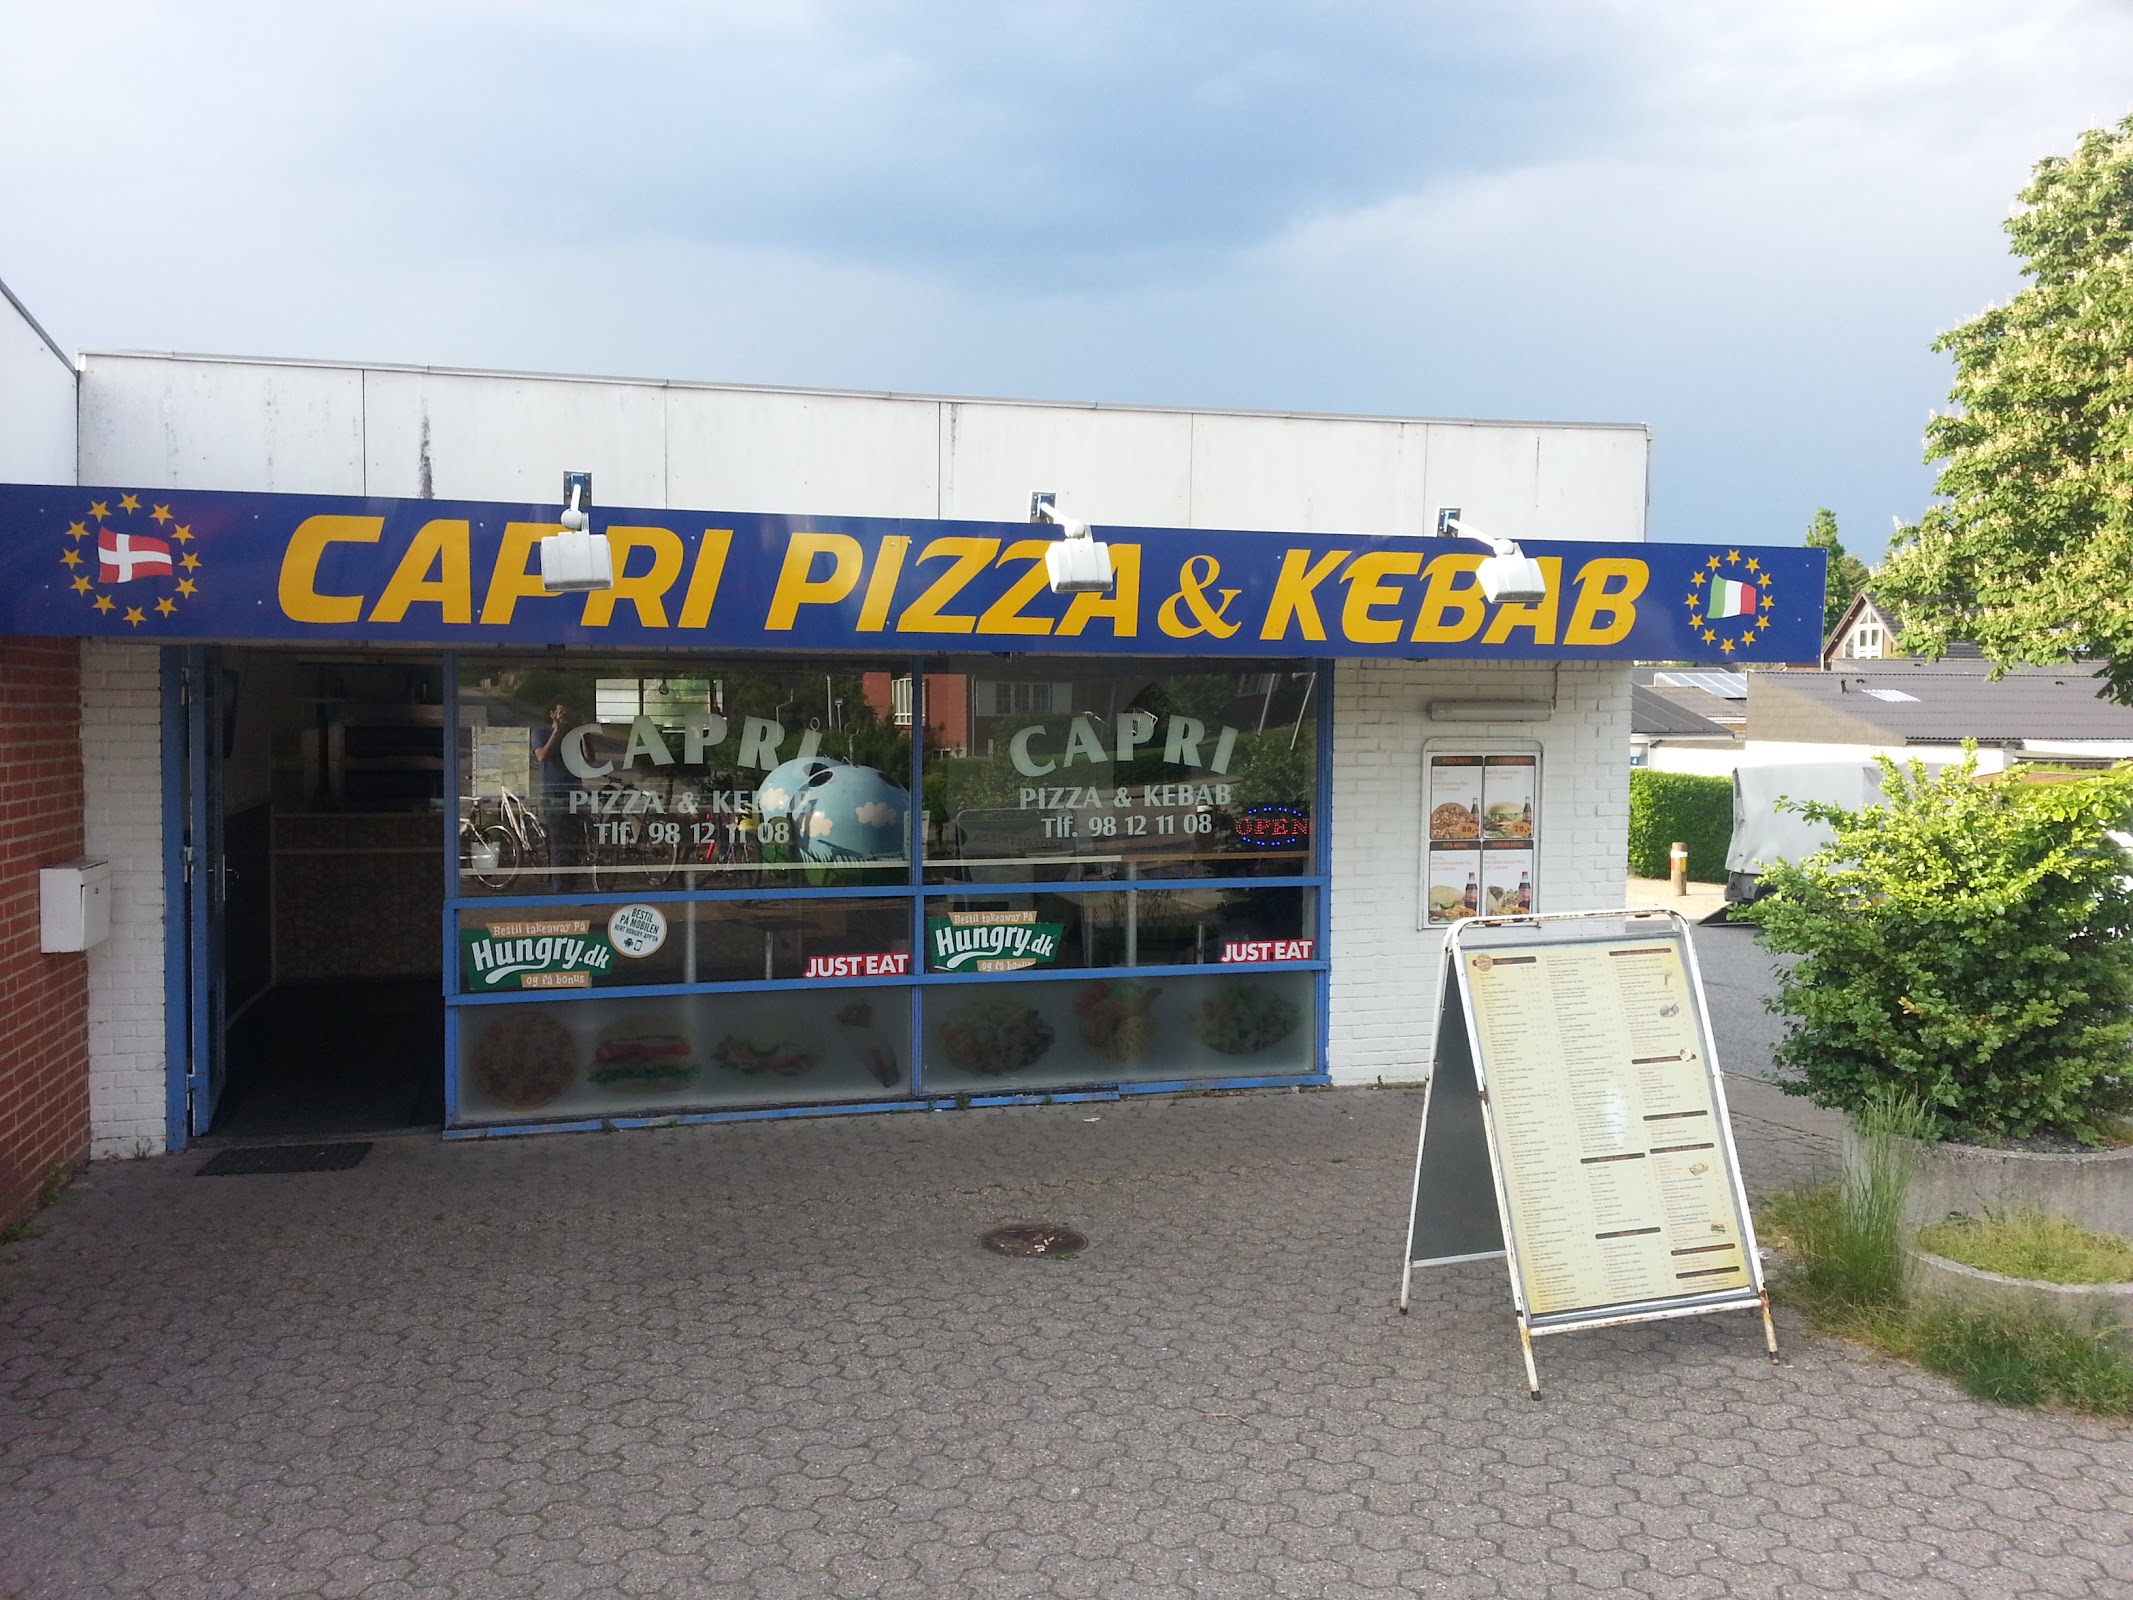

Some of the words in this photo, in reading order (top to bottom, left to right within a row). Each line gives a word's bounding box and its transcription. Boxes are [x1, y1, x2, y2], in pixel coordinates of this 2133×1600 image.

[278, 514, 734, 629] CAPRI
[764, 533, 1142, 638] PIZZA
[1157, 555, 1242, 639] &
[1259, 549, 1649, 646] KEBAB
[560, 713, 823, 778] CAPRI
[1010, 713, 1238, 777] CAPRI
[568, 790, 664, 814] PIZZA
[678, 791, 699, 814] &
[1020, 786, 1102, 810] PIZZA
[1114, 787, 1132, 808] &
[1144, 784, 1232, 807] KEBAB
[649, 822, 681, 844] 98
[690, 822, 715, 844] 12
[726, 822, 746, 843] 11
[757, 822, 790, 844] 08
[1041, 815, 1078, 838] Tlf.
[1089, 816, 1117, 837] 98
[1125, 815, 1146, 836] 12
[1156, 815, 1174, 835] 11
[1184, 814, 1212, 834] 08
[1235, 818, 1309, 836] OPEN
[619, 914, 630, 926] PÅ
[630, 918, 660, 935] MOBILEN
[631, 908, 653, 922] BESTIL
[954, 914, 979, 924] Bestil
[982, 913, 1021, 923] takeaway
[493, 924, 522, 936] Bestil
[526, 923, 571, 935] takeaway
[935, 926, 1054, 967] Hungry.dk
[1222, 943, 1271, 962] JUST
[1274, 941, 1312, 960] EAT
[471, 937, 610, 982] Hungry.dk
[805, 956, 862, 977] JUST
[866, 954, 908, 974] EAT
[982, 962, 992, 972] og
[526, 977, 538, 986] og
[541, 974, 553, 985] få
[556, 974, 585, 985] bonus
